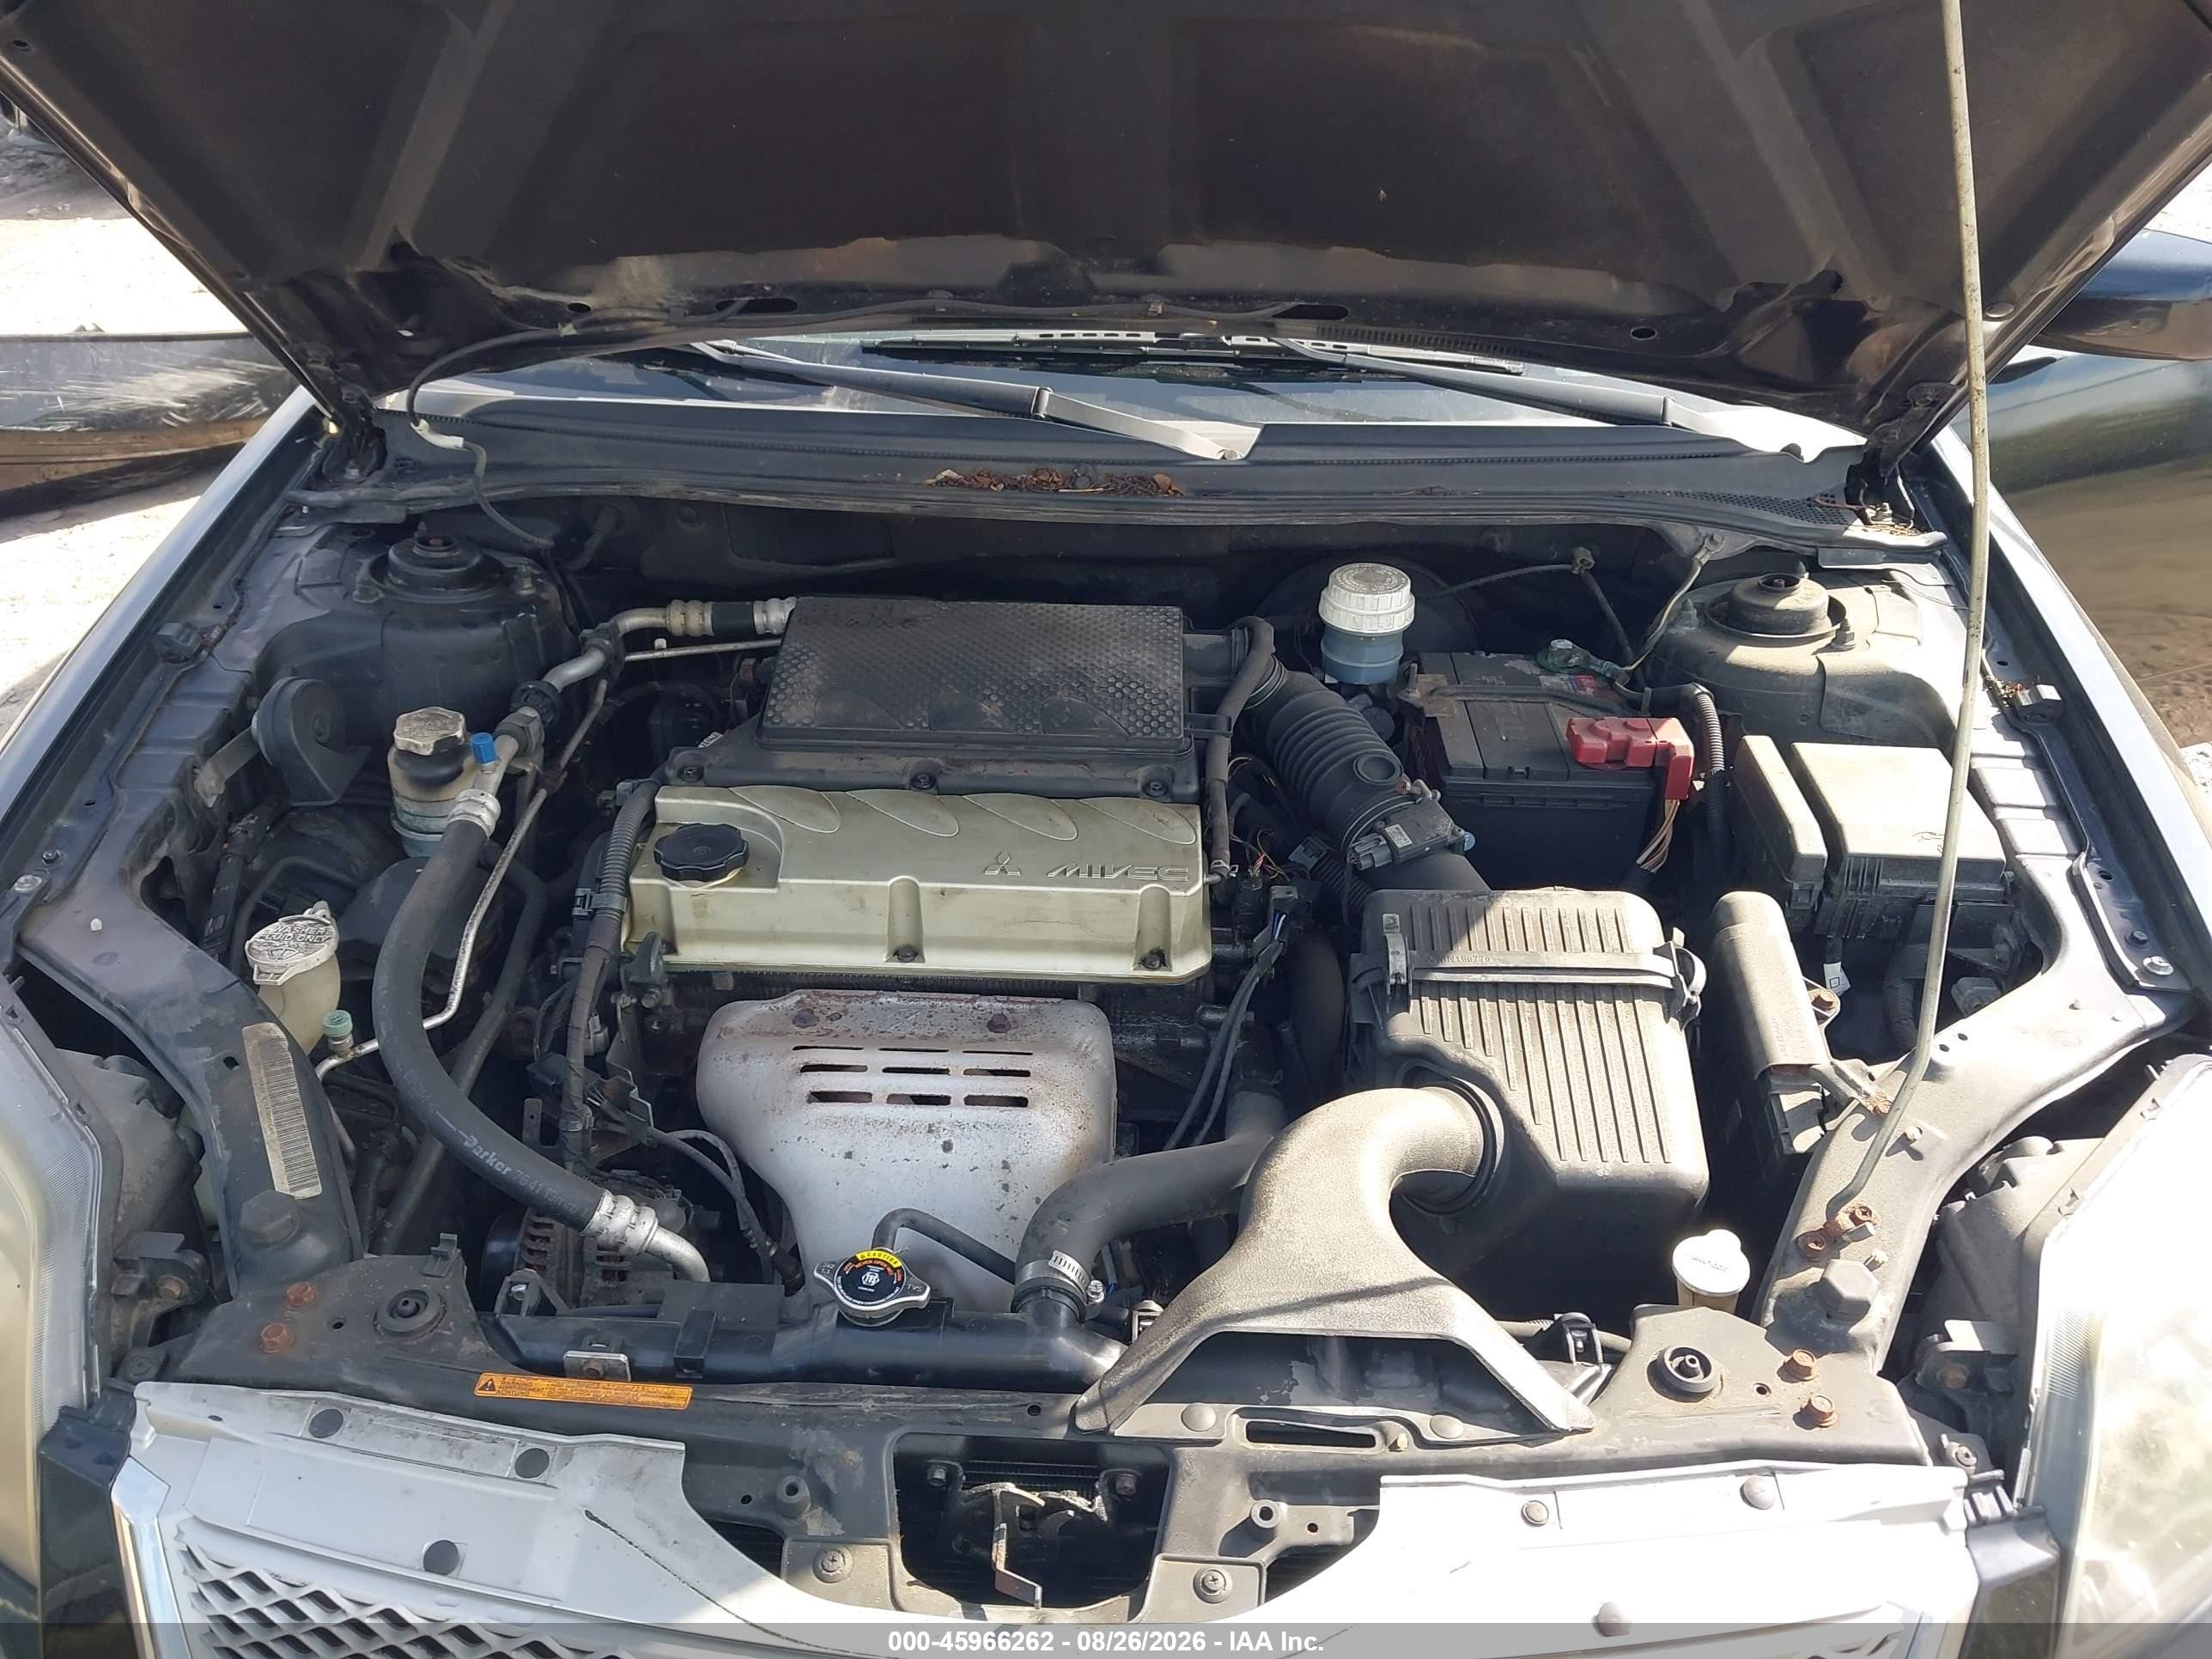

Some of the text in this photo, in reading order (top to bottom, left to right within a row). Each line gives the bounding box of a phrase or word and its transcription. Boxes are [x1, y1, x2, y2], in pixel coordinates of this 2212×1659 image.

[1046, 862, 1189, 881] MIVEC
[275, 926, 326, 934] WASHER
[461, 1133, 513, 1176] Parker
[514, 1169, 544, 1194] 7641
[906, 1283, 923, 1292] TVS
